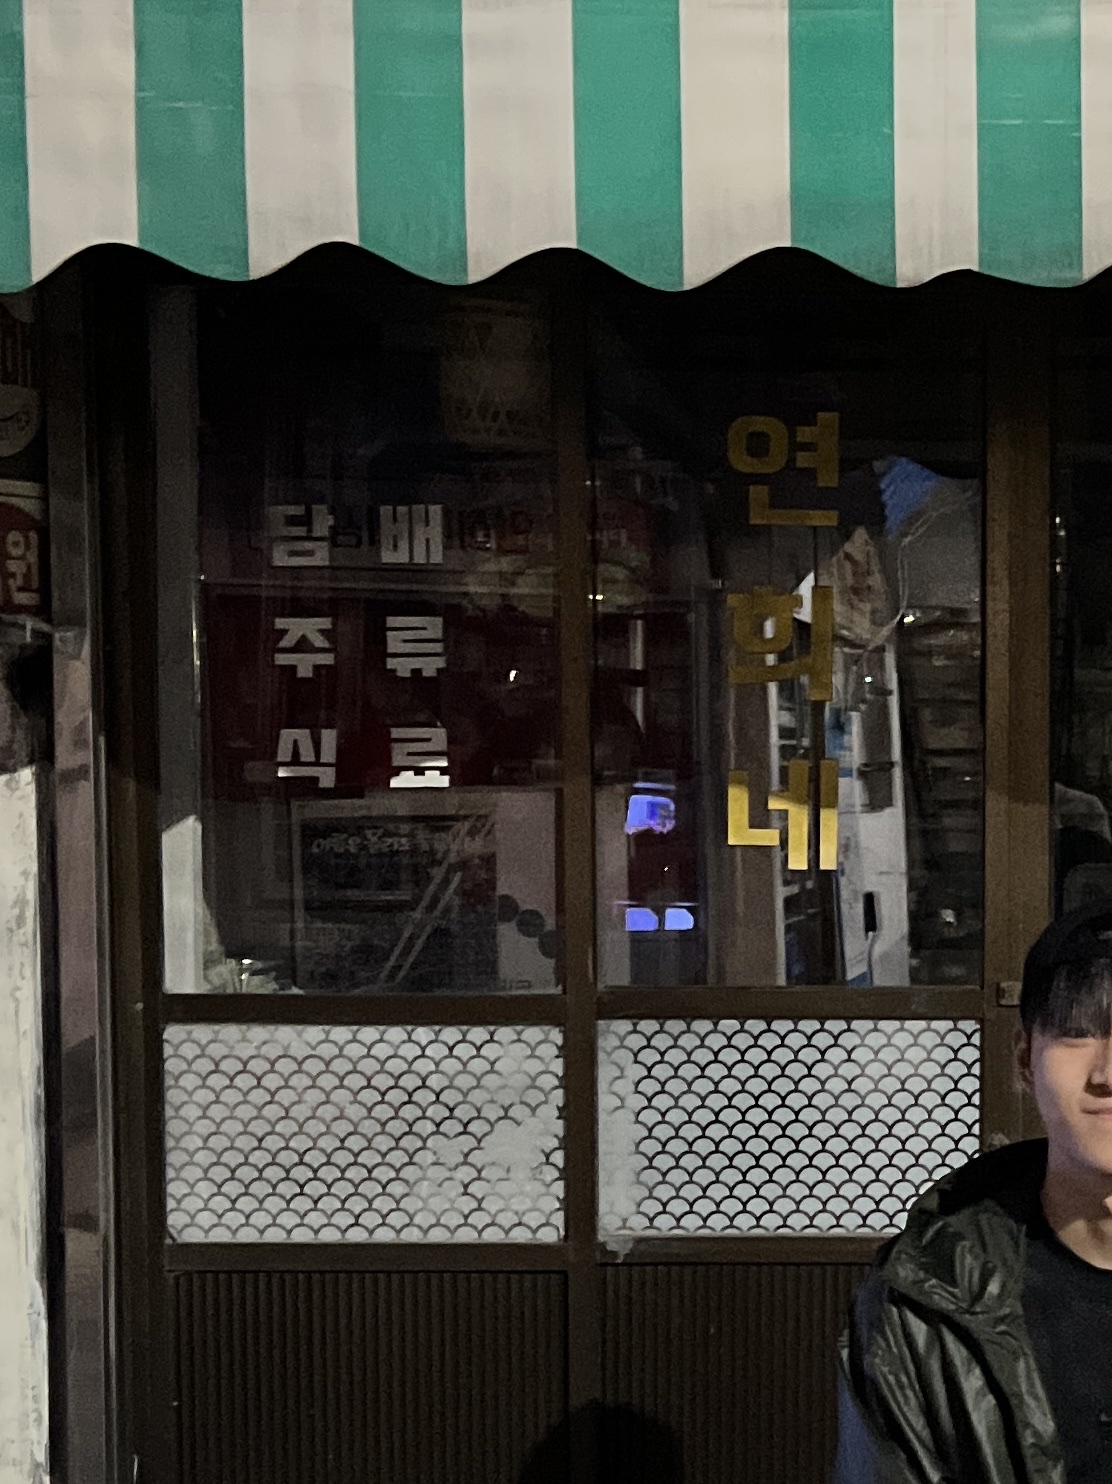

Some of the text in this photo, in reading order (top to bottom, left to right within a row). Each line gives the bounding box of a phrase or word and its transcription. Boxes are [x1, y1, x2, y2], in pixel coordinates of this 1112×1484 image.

[267, 503, 445, 567] 담배
[274, 616, 447, 678] 주류
[727, 411, 839, 871] 연희네
[276, 727, 450, 789] 식료
